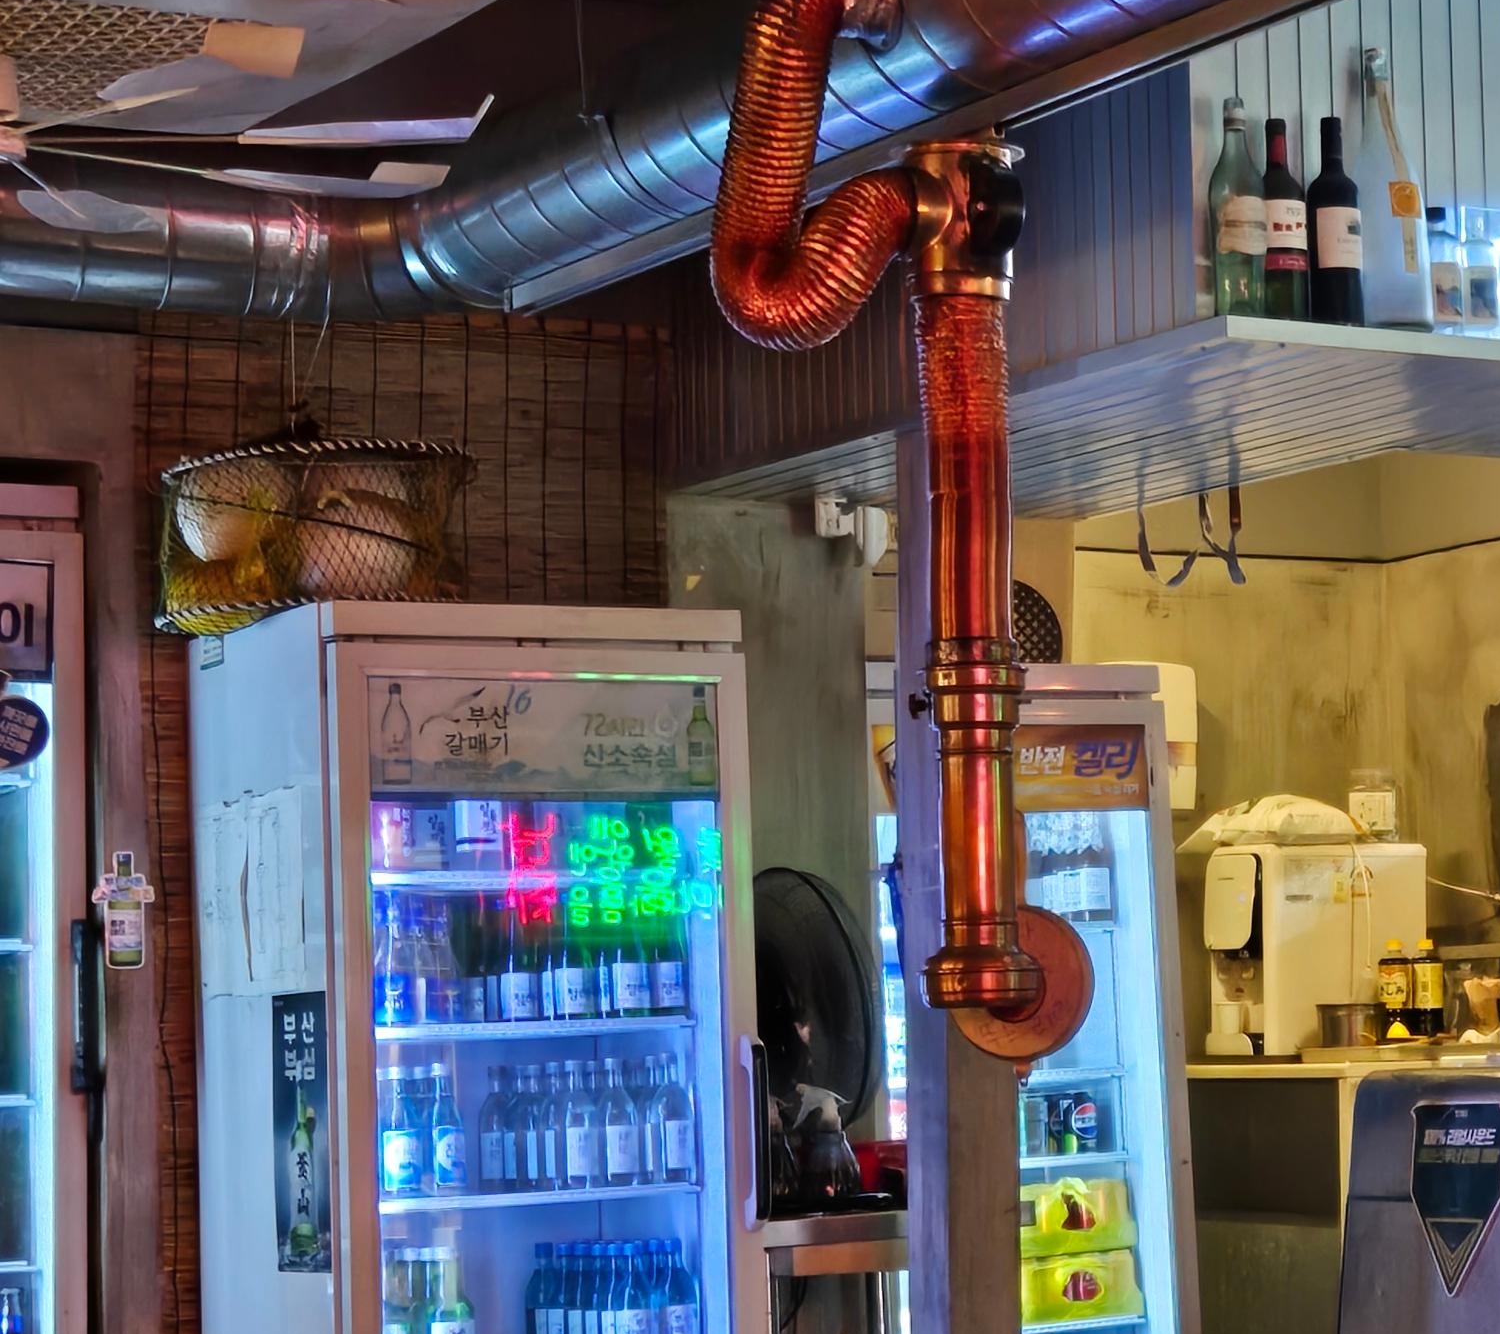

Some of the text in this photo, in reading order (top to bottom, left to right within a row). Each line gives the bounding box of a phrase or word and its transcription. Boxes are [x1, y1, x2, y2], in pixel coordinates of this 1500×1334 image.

[466, 705, 509, 730] 부산
[445, 731, 509, 757] 갈매기
[1020, 746, 1066, 775] 반전
